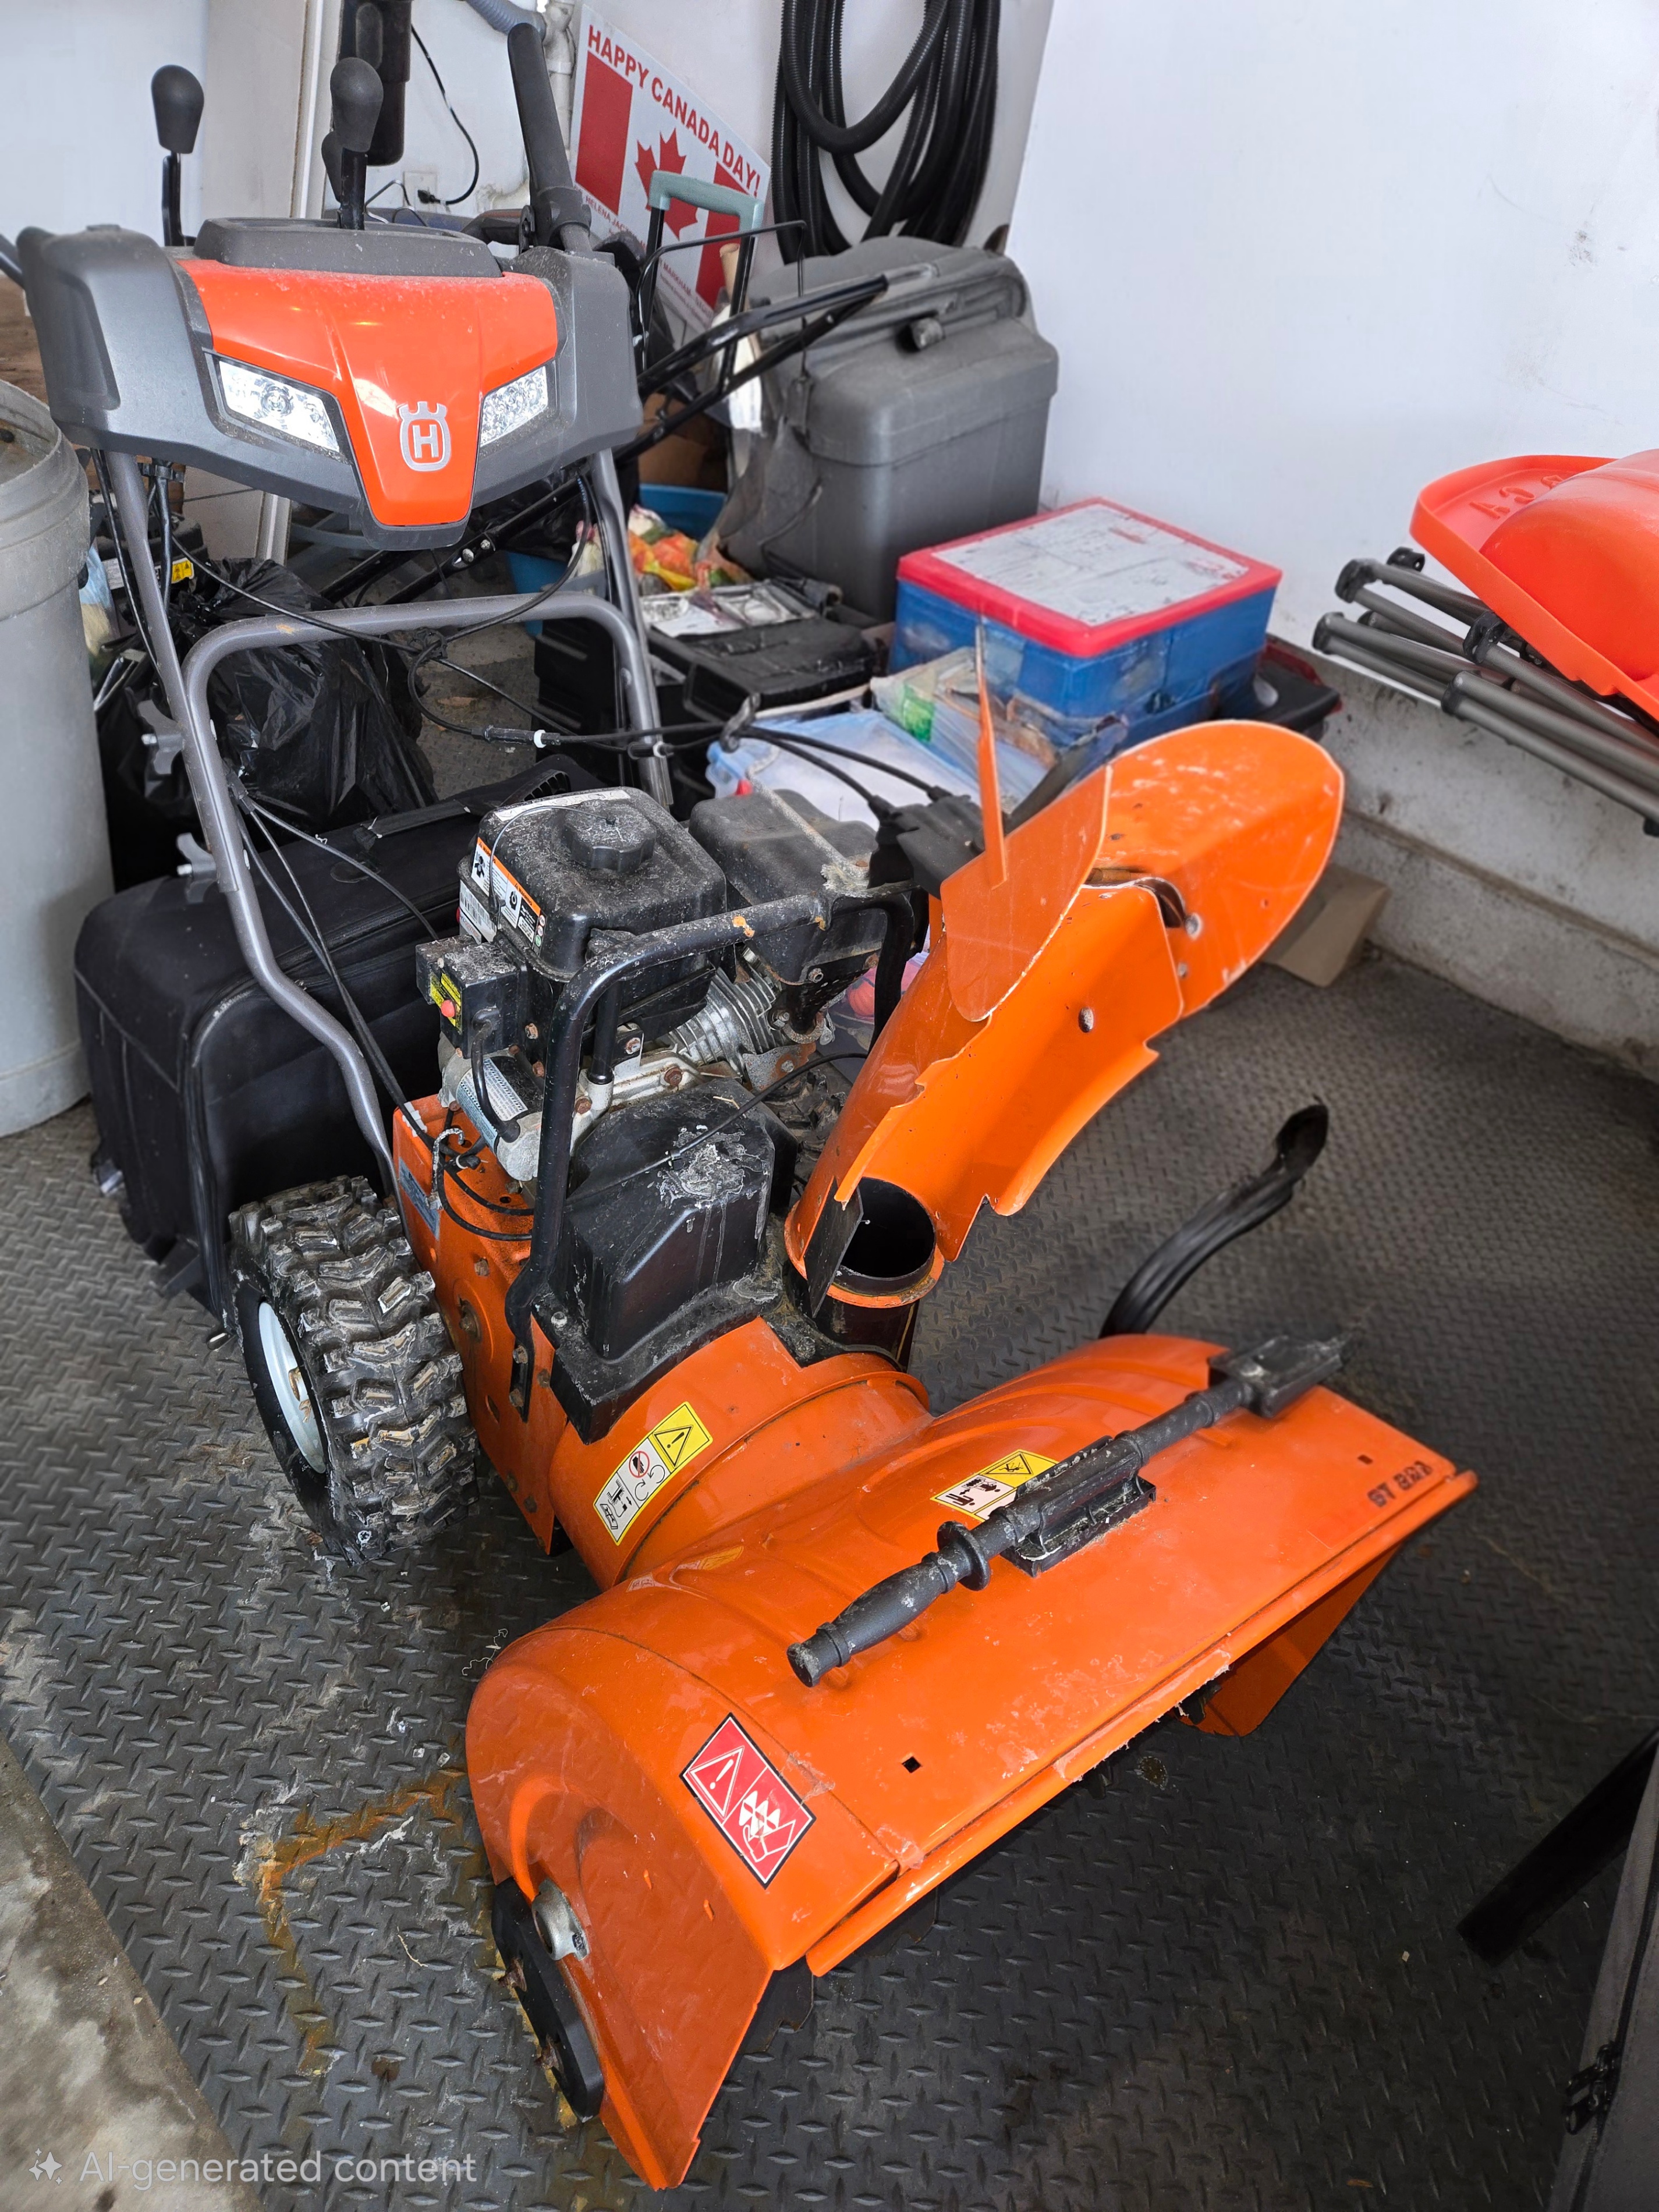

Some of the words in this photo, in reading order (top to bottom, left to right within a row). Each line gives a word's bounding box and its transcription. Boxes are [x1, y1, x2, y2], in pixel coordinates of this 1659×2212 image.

[588, 24, 650, 89] HAPPY
[651, 77, 719, 158] CANADA
[722, 140, 761, 198] DAY!
